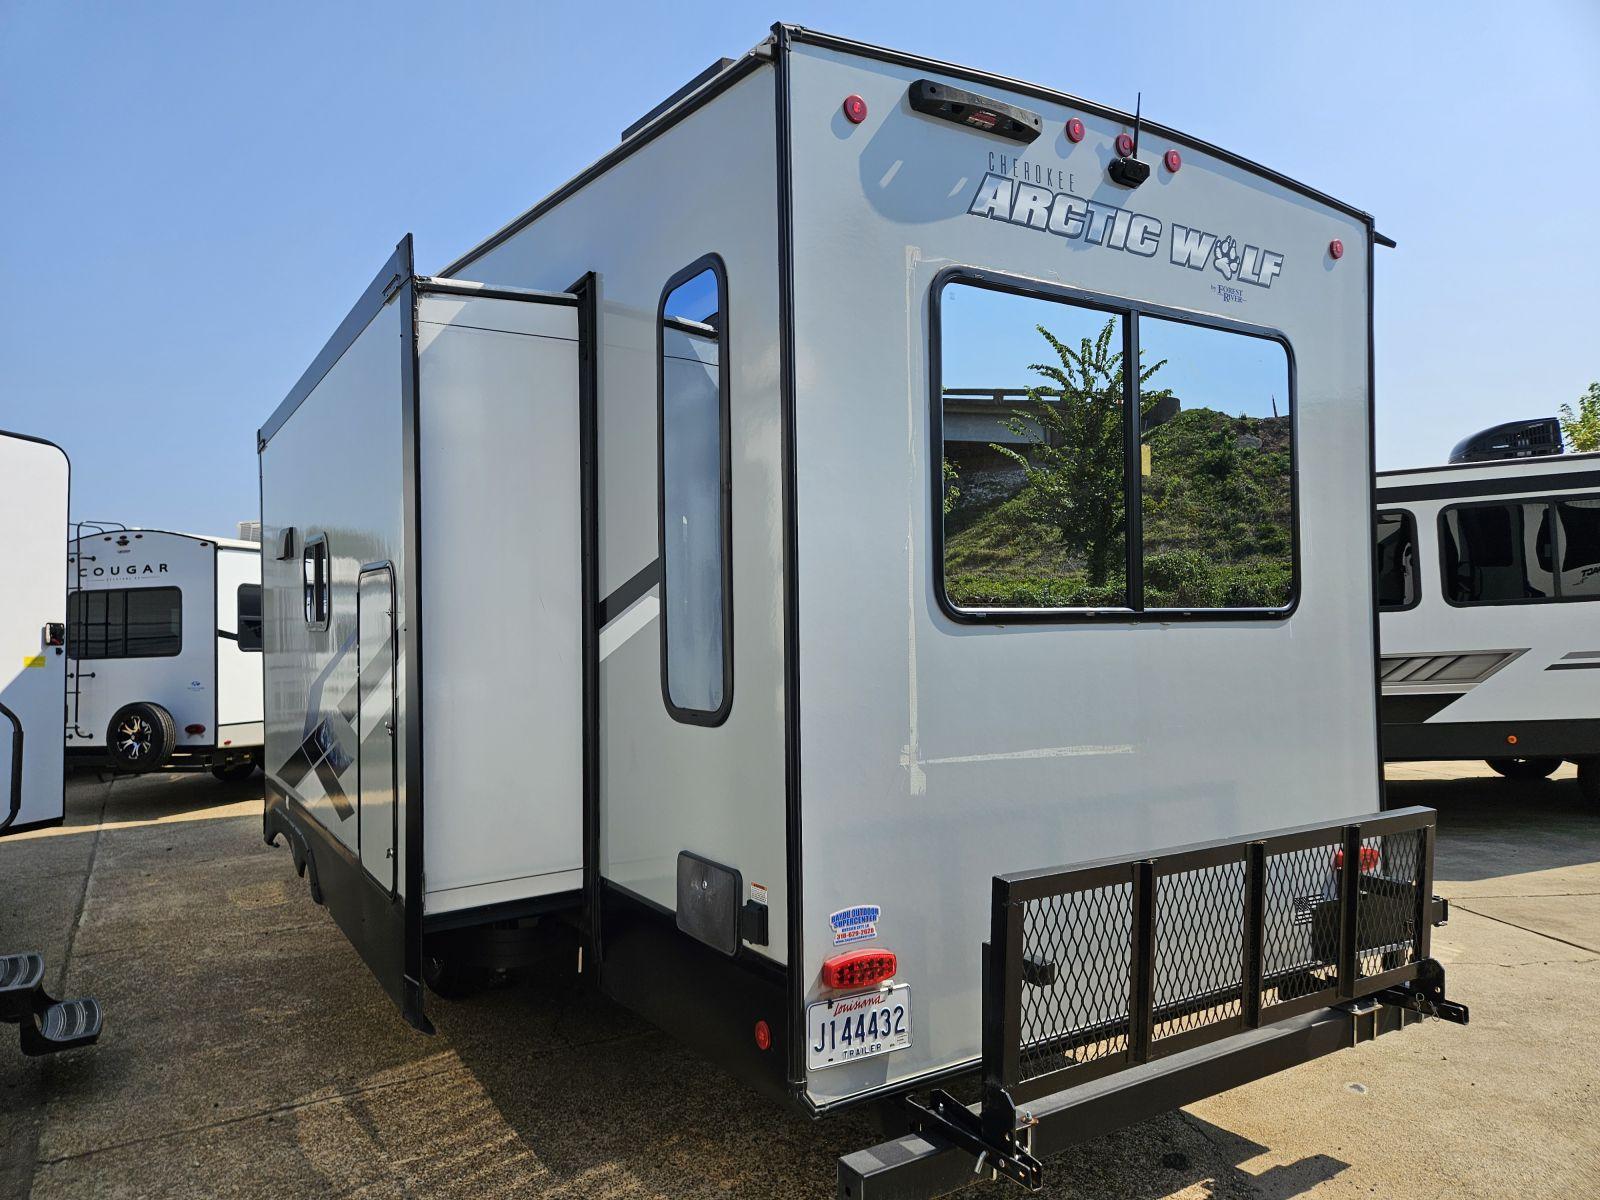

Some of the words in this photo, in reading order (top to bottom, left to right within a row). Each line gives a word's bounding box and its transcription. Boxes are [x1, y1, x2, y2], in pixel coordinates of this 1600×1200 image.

[988, 151, 1075, 193] CHEROKEE
[966, 171, 1163, 258] ARCTIC
[1217, 284, 1243, 297] FOREST
[1223, 292, 1243, 303] RIVER
[79, 563, 168, 577] COUGAR
[831, 910, 850, 923] BAYOU
[851, 907, 879, 917] OUTDOOR
[833, 915, 877, 928] SUPERCENTER
[833, 995, 886, 1017] Louisiana
[814, 1005, 906, 1052] J144432
[843, 1043, 882, 1058] TRAILER
